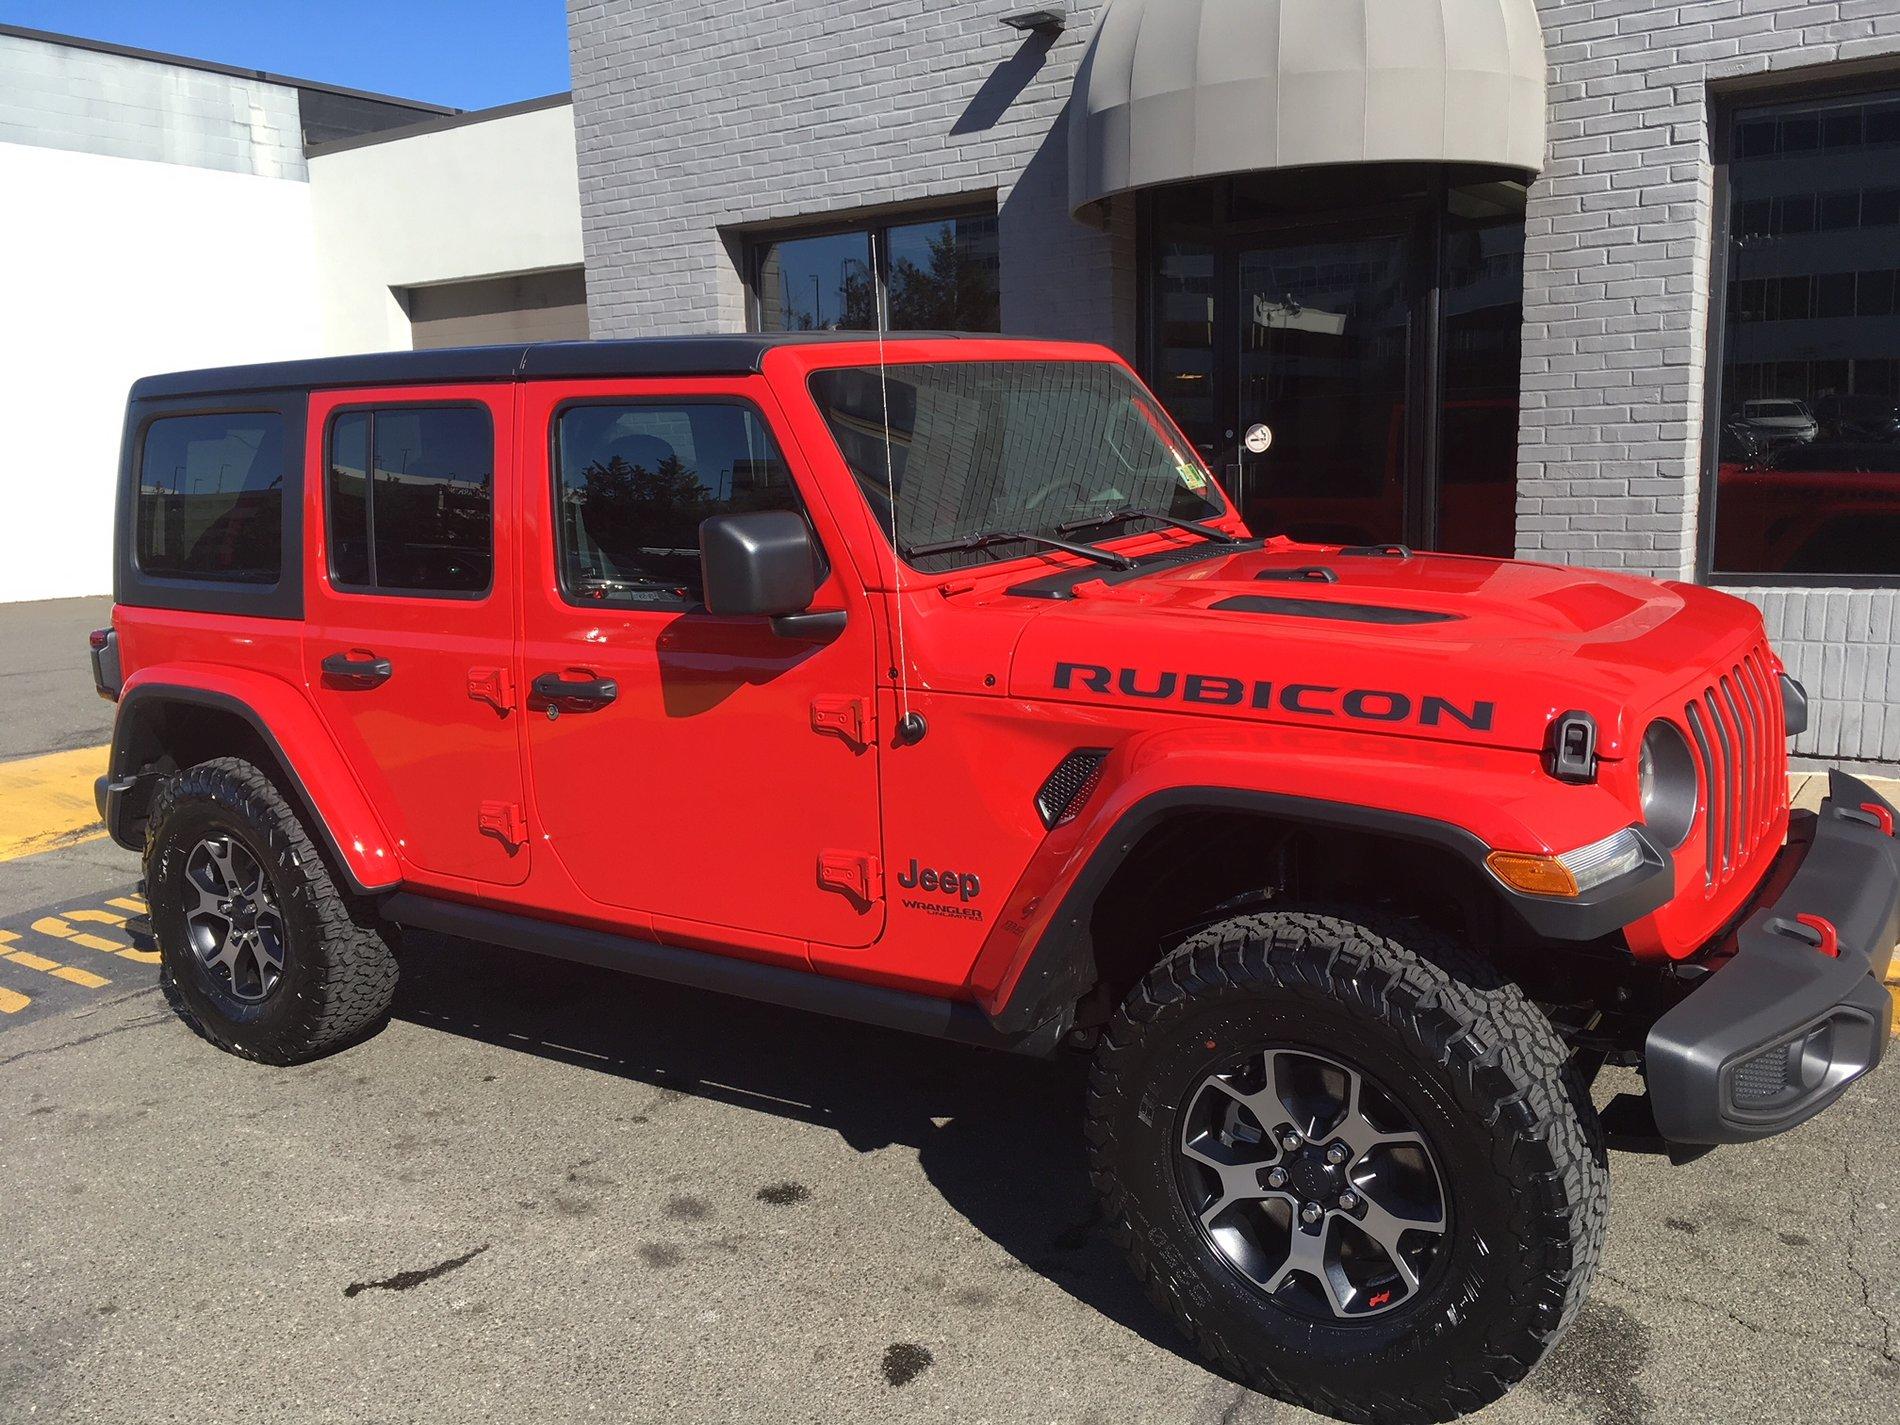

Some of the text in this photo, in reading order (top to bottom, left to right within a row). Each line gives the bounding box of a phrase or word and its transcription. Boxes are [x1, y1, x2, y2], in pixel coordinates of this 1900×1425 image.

[1053, 661, 1497, 731] RUBICON
[897, 858, 981, 902] Jeep
[902, 898, 982, 917] WRANGLER
